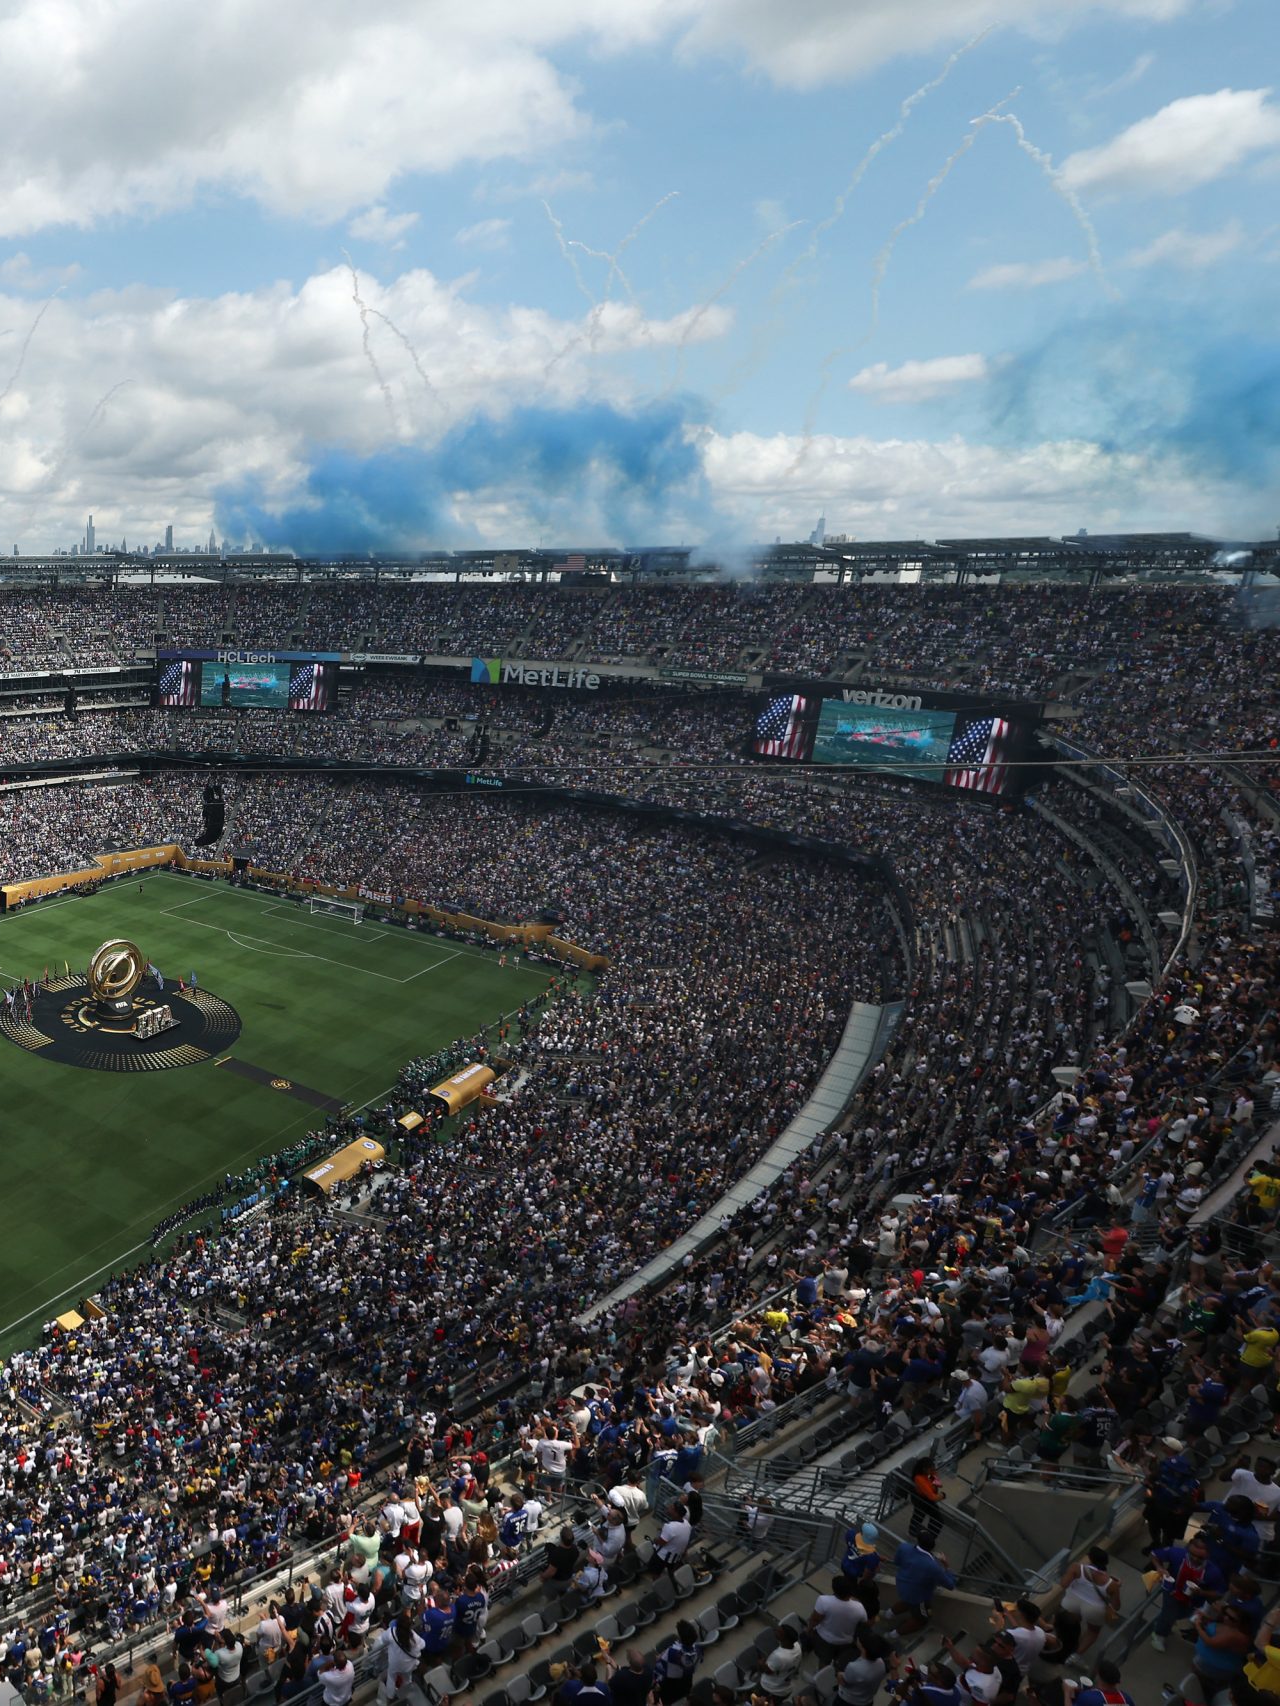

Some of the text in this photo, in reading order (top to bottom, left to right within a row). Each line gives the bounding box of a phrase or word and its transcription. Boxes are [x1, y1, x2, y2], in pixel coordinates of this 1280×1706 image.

[217, 651, 276, 663] HCLTech
[503, 664, 600, 690] MetLife
[713, 674, 747, 682] CHAMPIONS
[842, 688, 922, 711] verizon
[476, 777, 503, 787] MetLife
[358, 888, 393, 904] PARIS
[115, 1001, 128, 1009] FIFA
